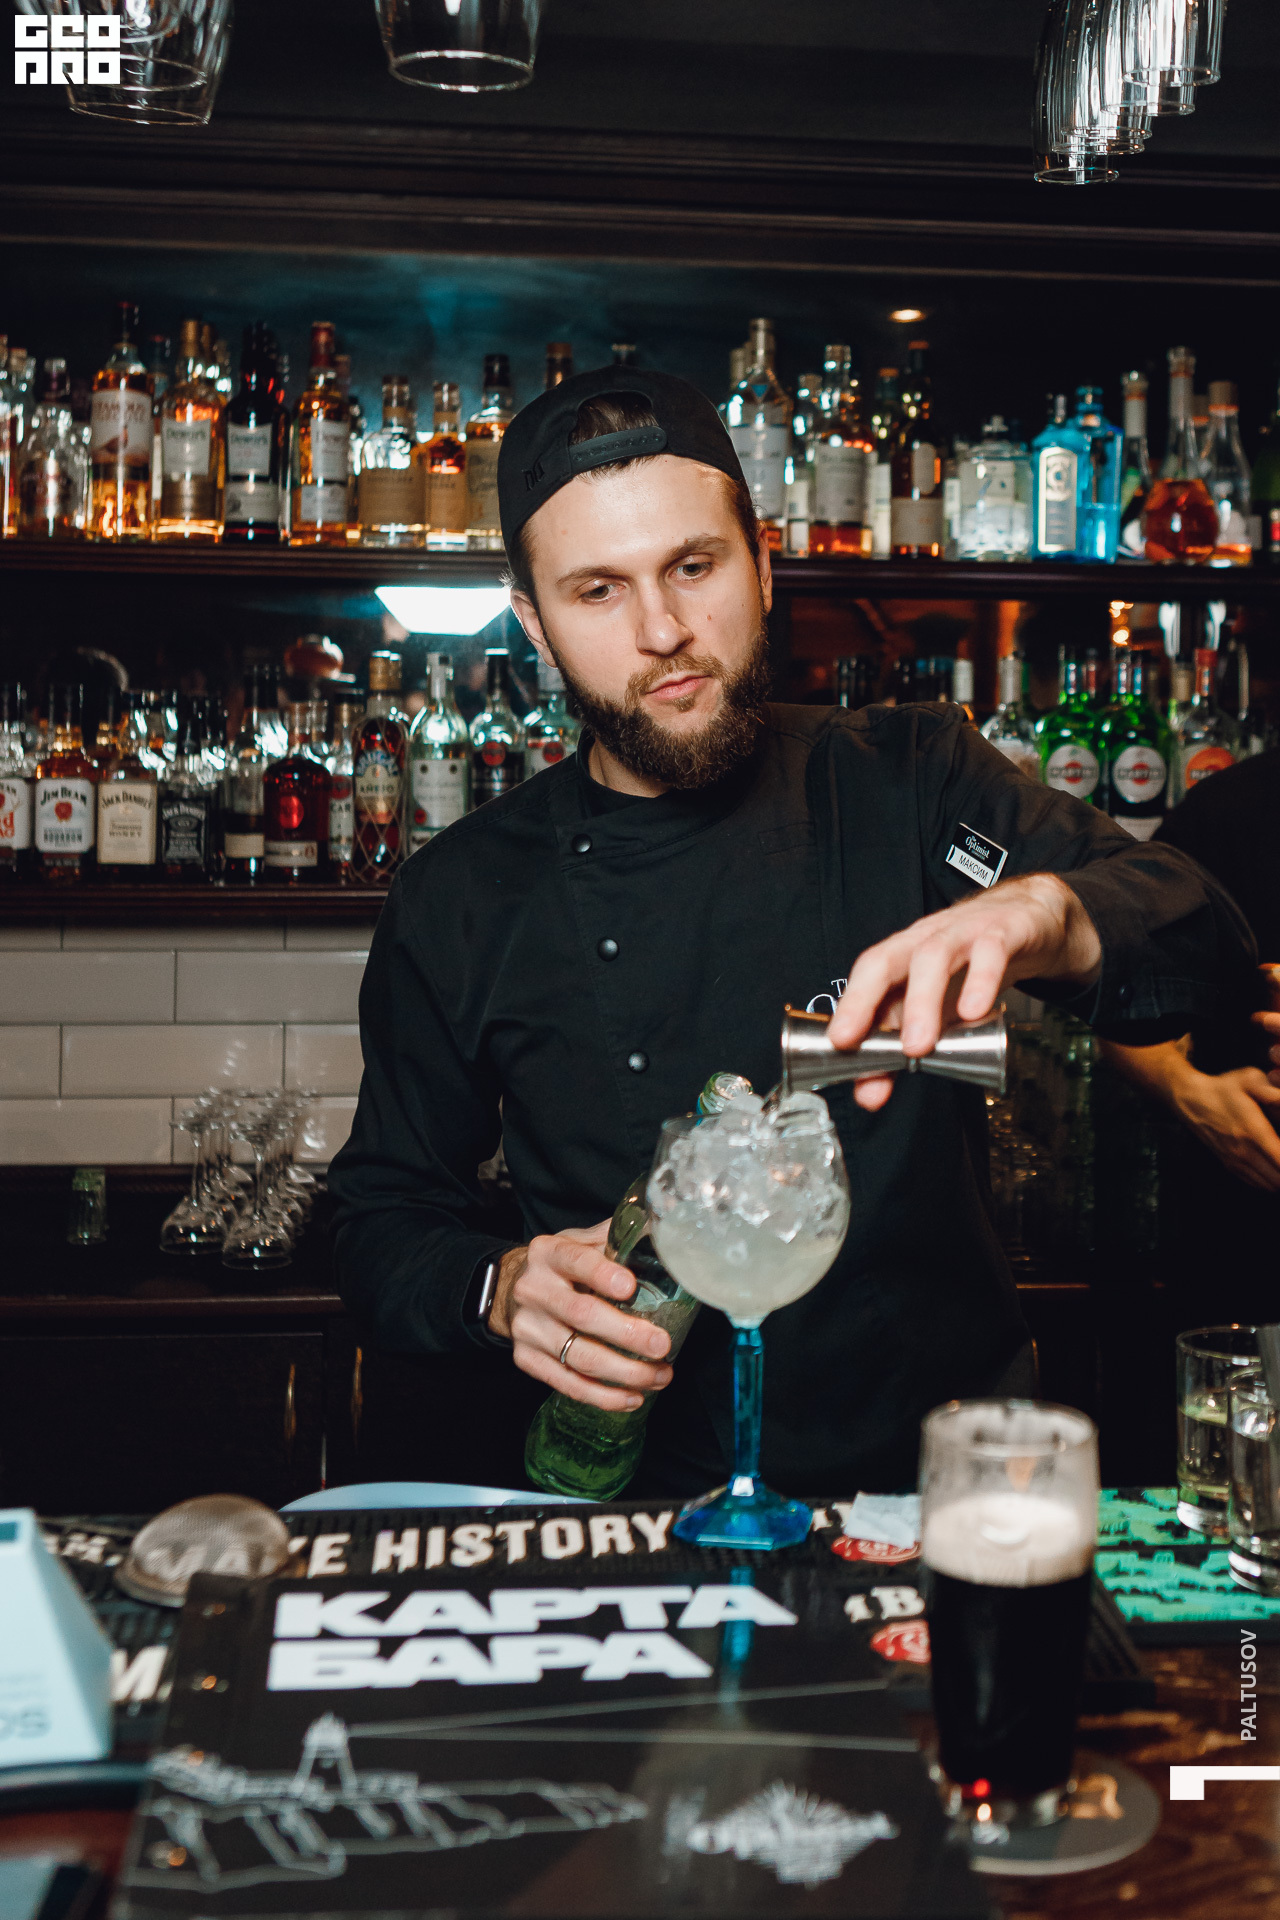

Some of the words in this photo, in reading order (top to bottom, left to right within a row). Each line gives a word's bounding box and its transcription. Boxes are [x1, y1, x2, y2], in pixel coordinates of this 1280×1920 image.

[959, 855, 989, 881] МАКСИМ
[371, 1510, 674, 1574] HISTORY
[273, 1584, 799, 1638] КАРТА
[266, 1631, 714, 1691] БАРА
